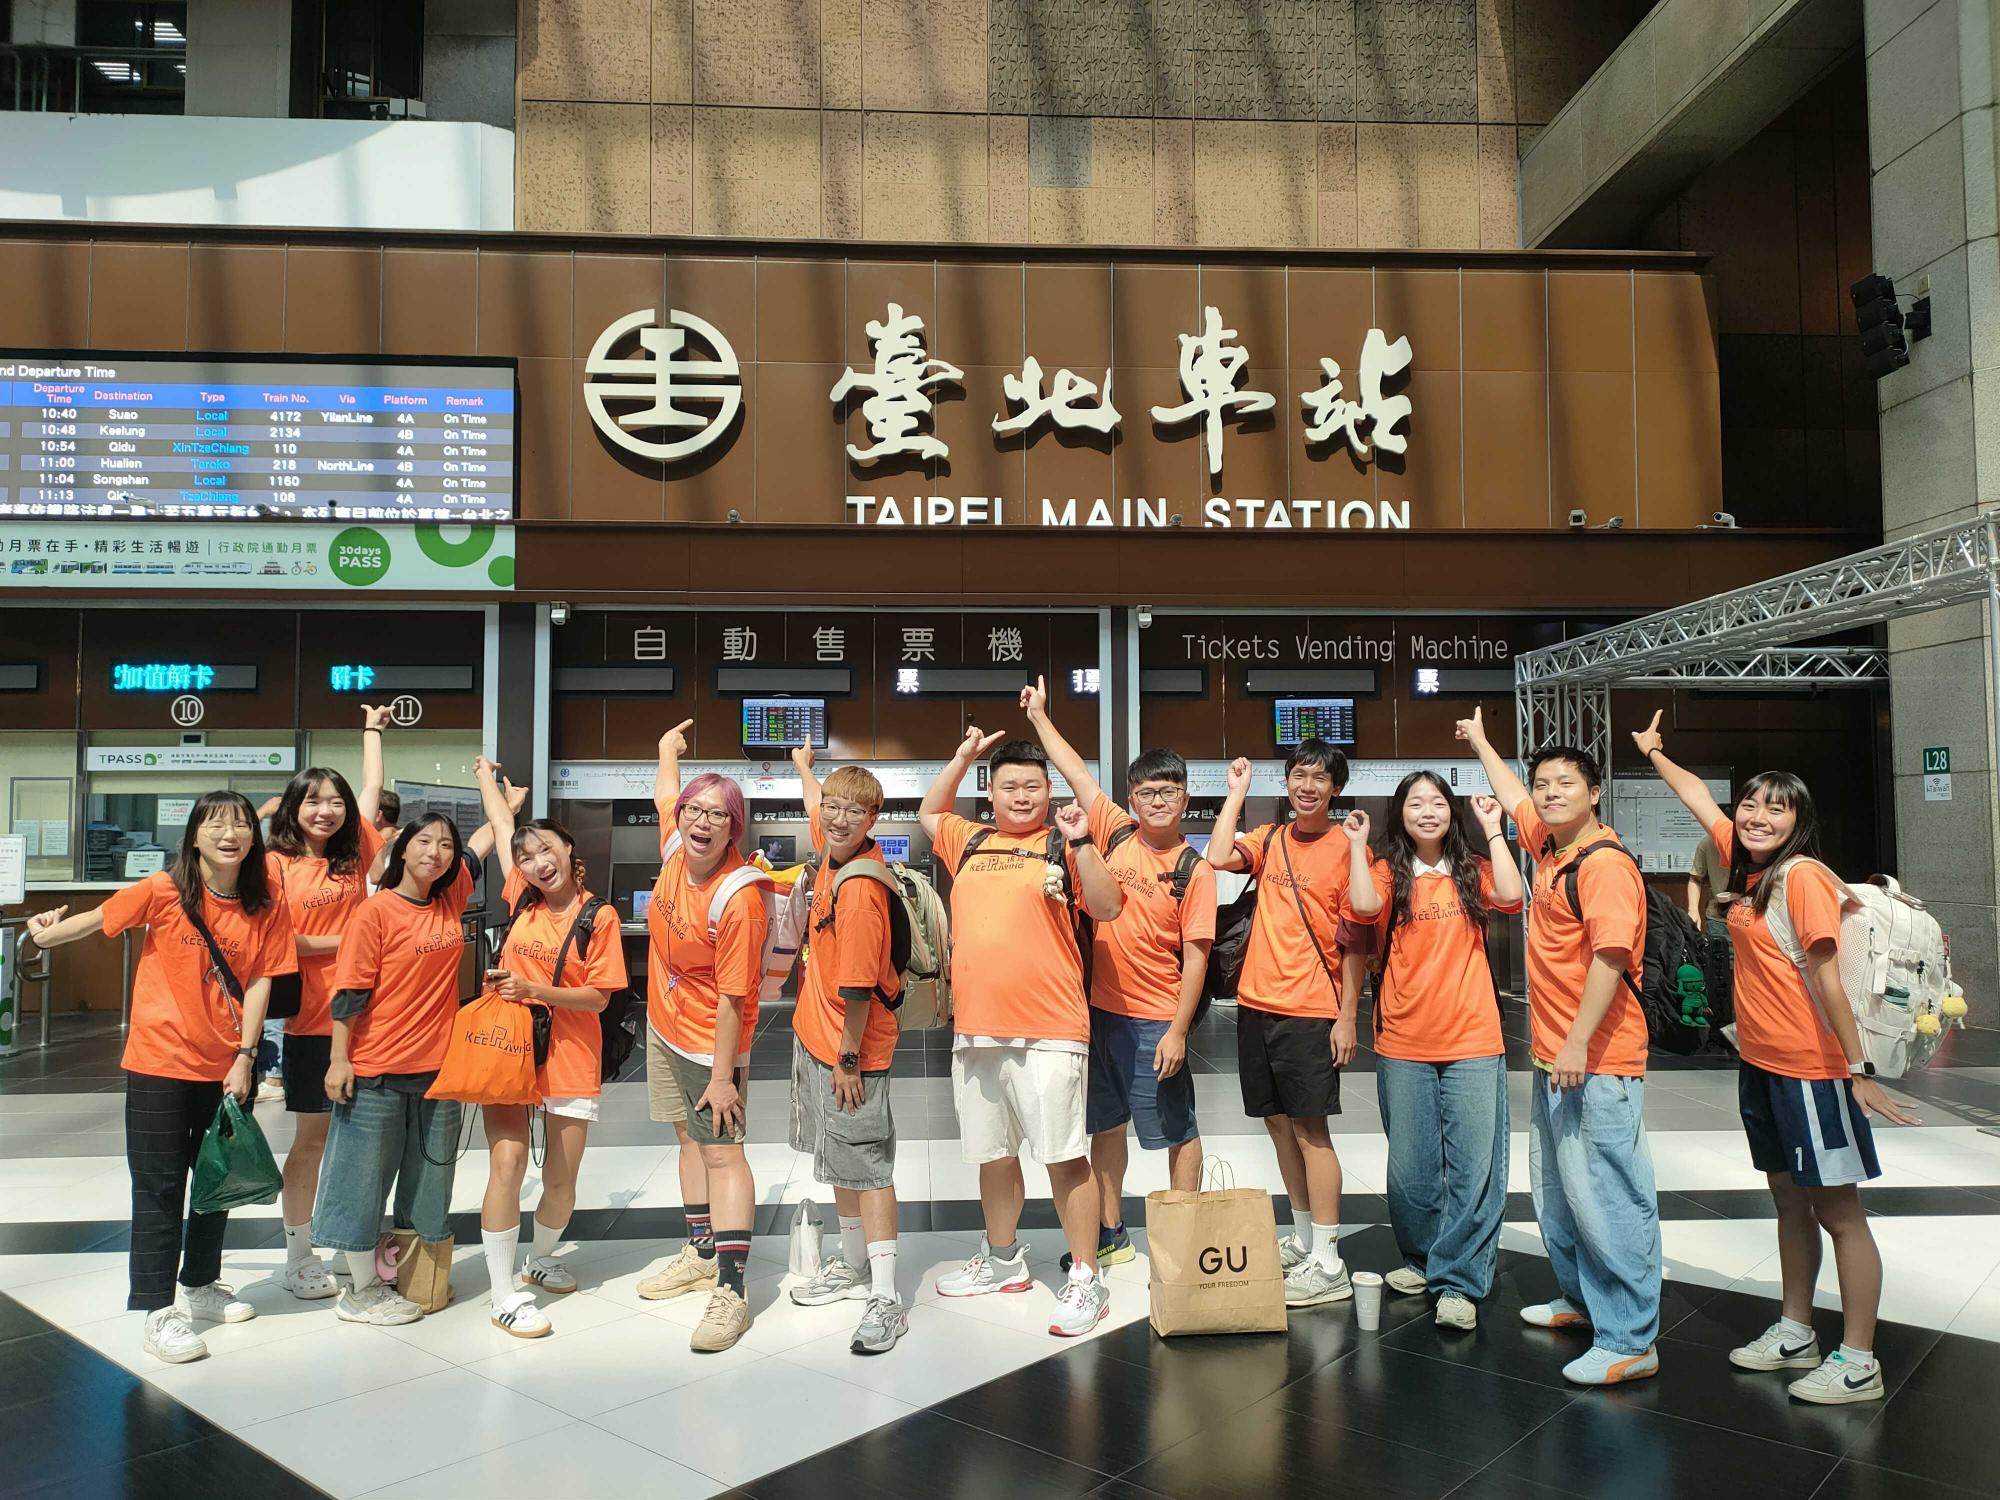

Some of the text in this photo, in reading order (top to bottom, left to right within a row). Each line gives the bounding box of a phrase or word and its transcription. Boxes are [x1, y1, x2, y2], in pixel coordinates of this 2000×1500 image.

[18, 366, 81, 378] Departure
[85, 367, 116, 378] Time
[34, 384, 85, 395] Departure
[830, 302, 1414, 474] 臺北車站
[47, 394, 72, 404] Time
[94, 391, 153, 401] Destination
[200, 392, 225, 403] Type
[263, 393, 310, 404] Train No.
[339, 395, 356, 404] Via
[384, 395, 428, 406] Platform
[446, 396, 484, 406] Remark
[41, 408, 77, 420] 10:40
[108, 409, 138, 420] Suao
[196, 410, 228, 421] Local
[269, 411, 302, 423] 4172
[396, 413, 415, 425] 4A
[443, 414, 487, 425] On Time
[41, 425, 76, 436] 10:48
[99, 426, 146, 438] Keelung
[195, 426, 227, 437] Local
[269, 427, 301, 438] 2134
[396, 429, 414, 440] 4B
[443, 430, 487, 441] On Time
[40, 441, 76, 452] 10:54
[108, 441, 136, 453] Qidu
[274, 443, 297, 455] 110
[396, 446, 414, 457] 4A
[443, 446, 487, 457] On Time
[39, 457, 75, 468] 11:00
[100, 458, 143, 469] Hualien
[191, 459, 231, 470] Taroko
[272, 460, 297, 471] 218
[317, 461, 374, 472] NorthLine
[396, 462, 414, 472] 4B
[443, 462, 487, 473] On Time
[39, 474, 75, 484] 11:04
[92, 474, 150, 486] Songshan
[194, 475, 226, 486] Local
[269, 476, 300, 487] 1160
[396, 478, 414, 489] 4A
[443, 478, 487, 489] On Time
[39, 490, 74, 501] 11:13
[396, 494, 414, 505] 4A
[443, 494, 487, 505] On Time
[1042, 498, 1167, 528] MAIN
[1205, 498, 1410, 529] STATION
[339, 545, 382, 556] 30days
[339, 556, 382, 568] PASS
[633, 625, 1024, 662] 自動售票機
[1182, 633, 1509, 663] Tickets Vending Machine
[179, 700, 199, 721] 10
[397, 700, 415, 721] 11
[98, 754, 142, 764] TPASS
[1926, 751, 1948, 771] L28
[1198, 1245, 1248, 1275] GU
[1199, 1280, 1250, 1290] YOUR FREEDOM
